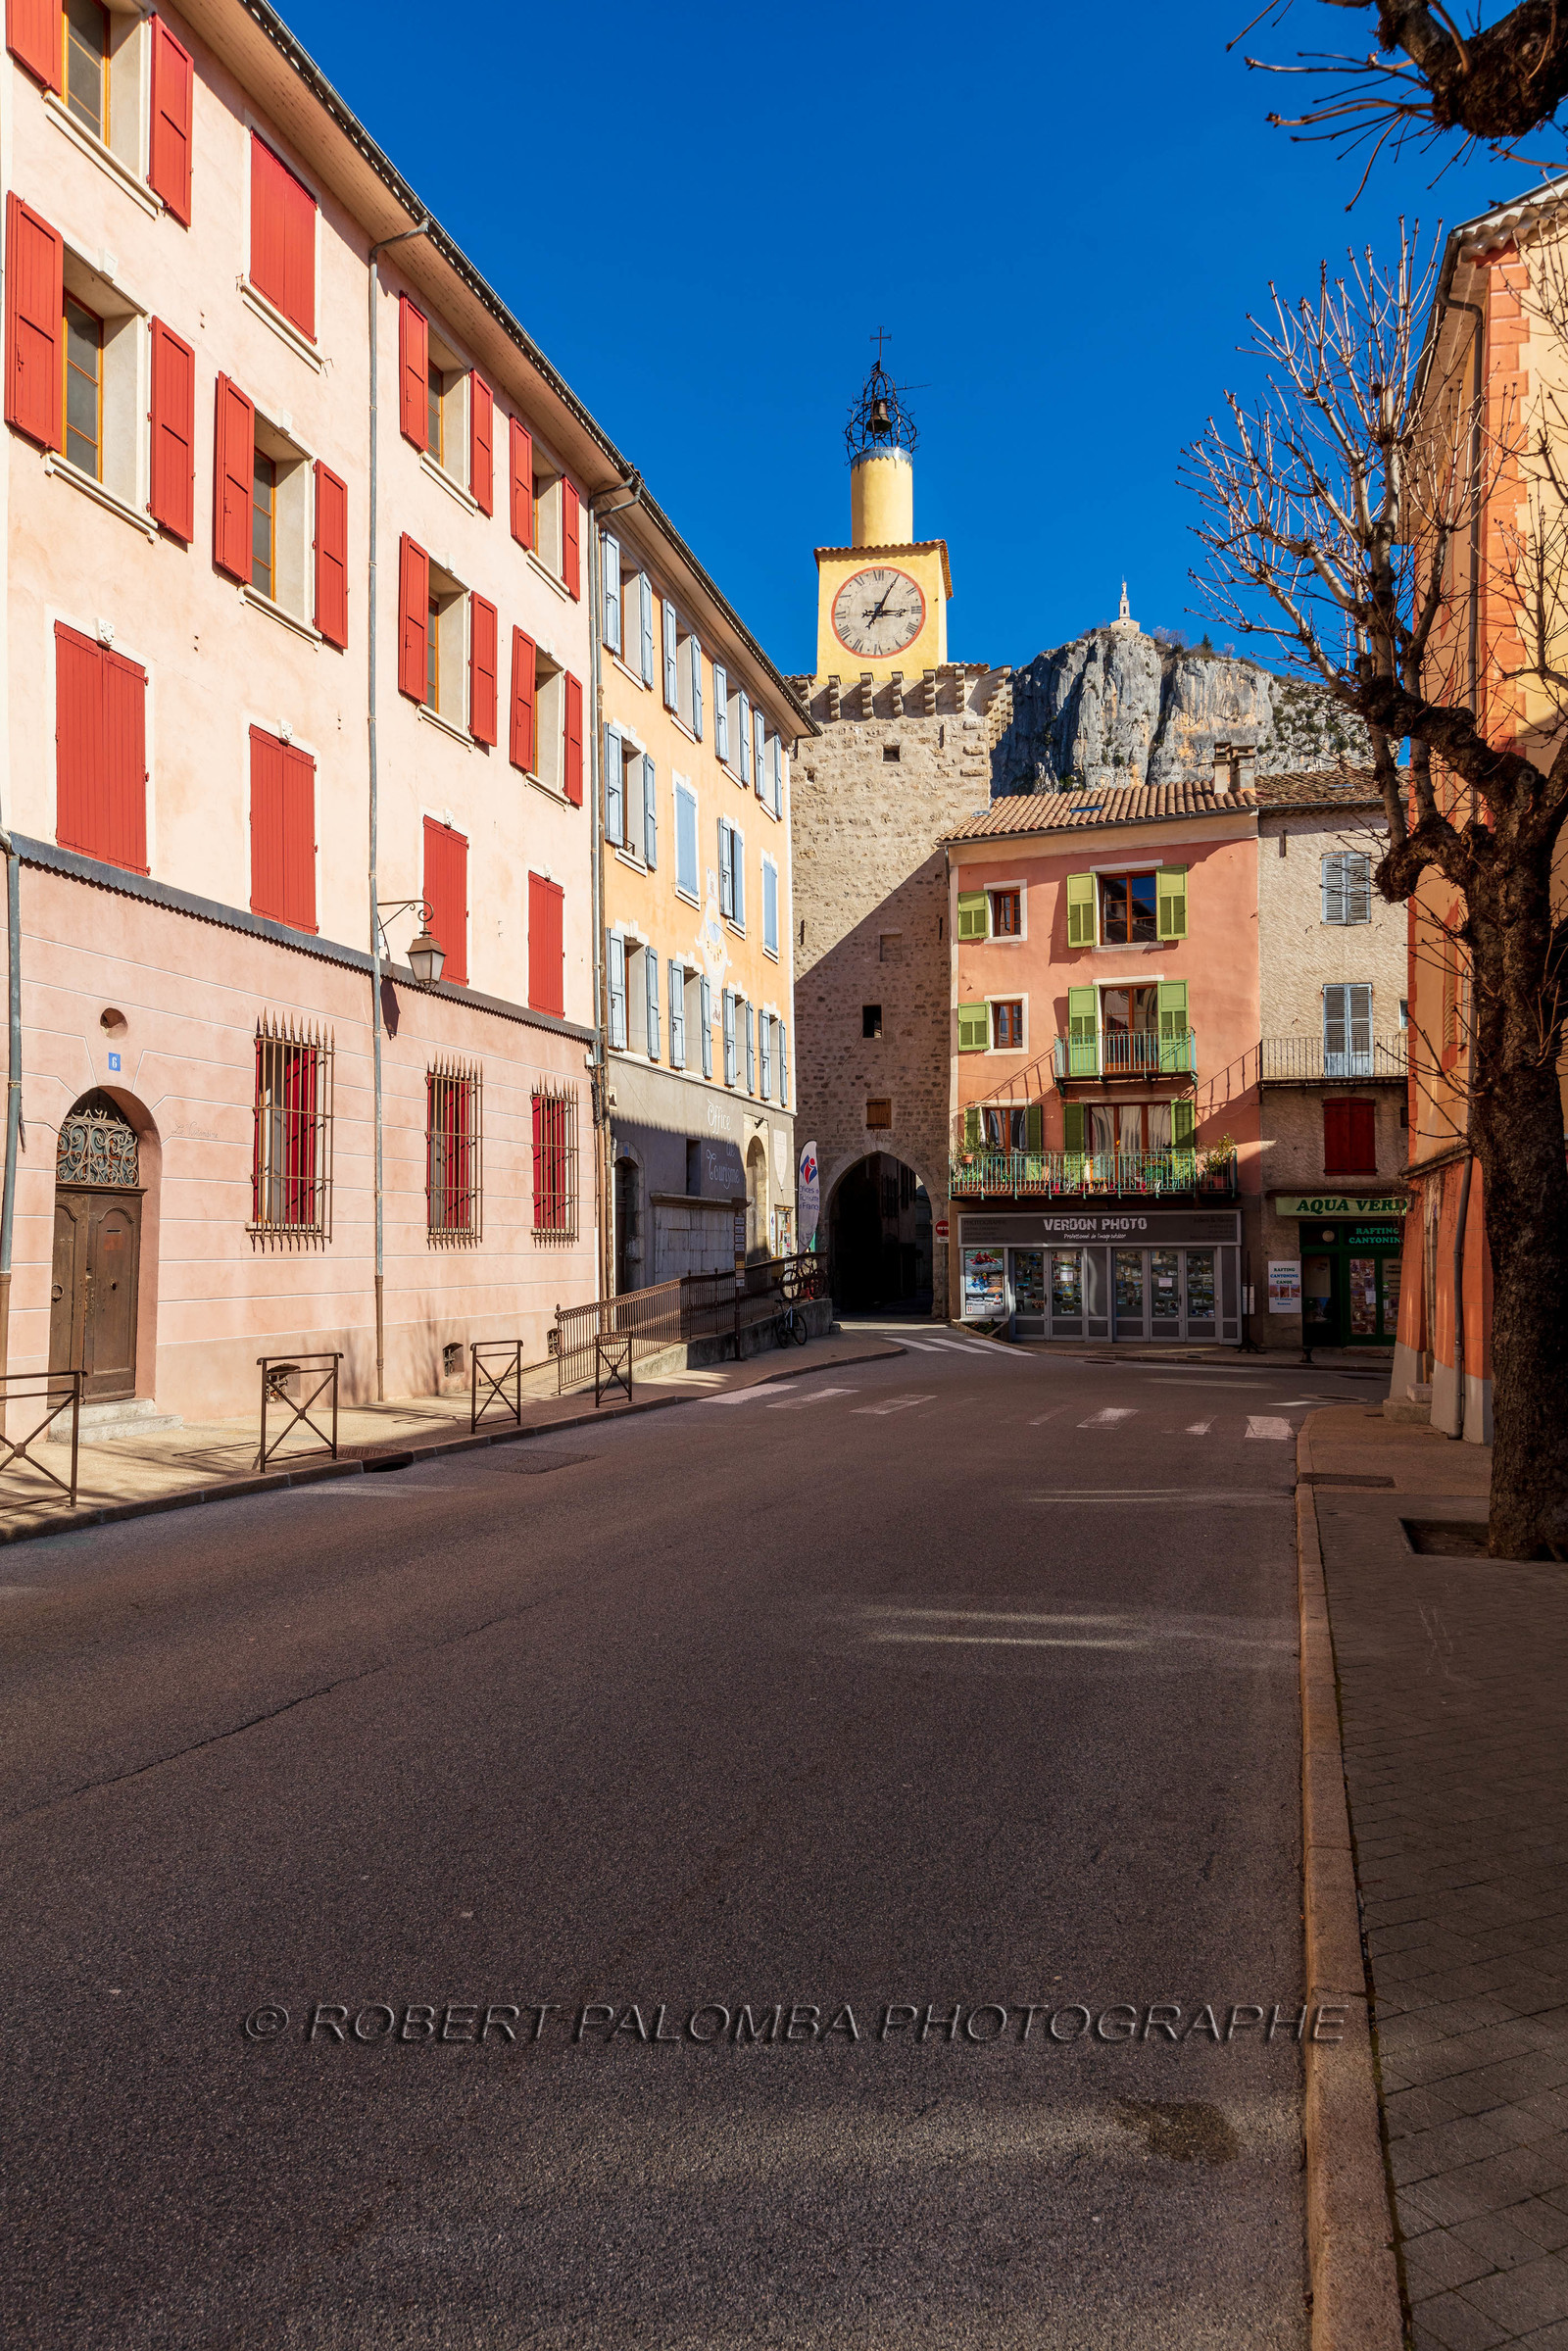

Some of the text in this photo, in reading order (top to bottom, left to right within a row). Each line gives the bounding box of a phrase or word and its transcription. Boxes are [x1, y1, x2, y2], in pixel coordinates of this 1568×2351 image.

[707, 1099, 732, 1135] Office
[1296, 1199, 1349, 1215] AQUA
[1043, 1217, 1148, 1231] VERDON PHOTO
